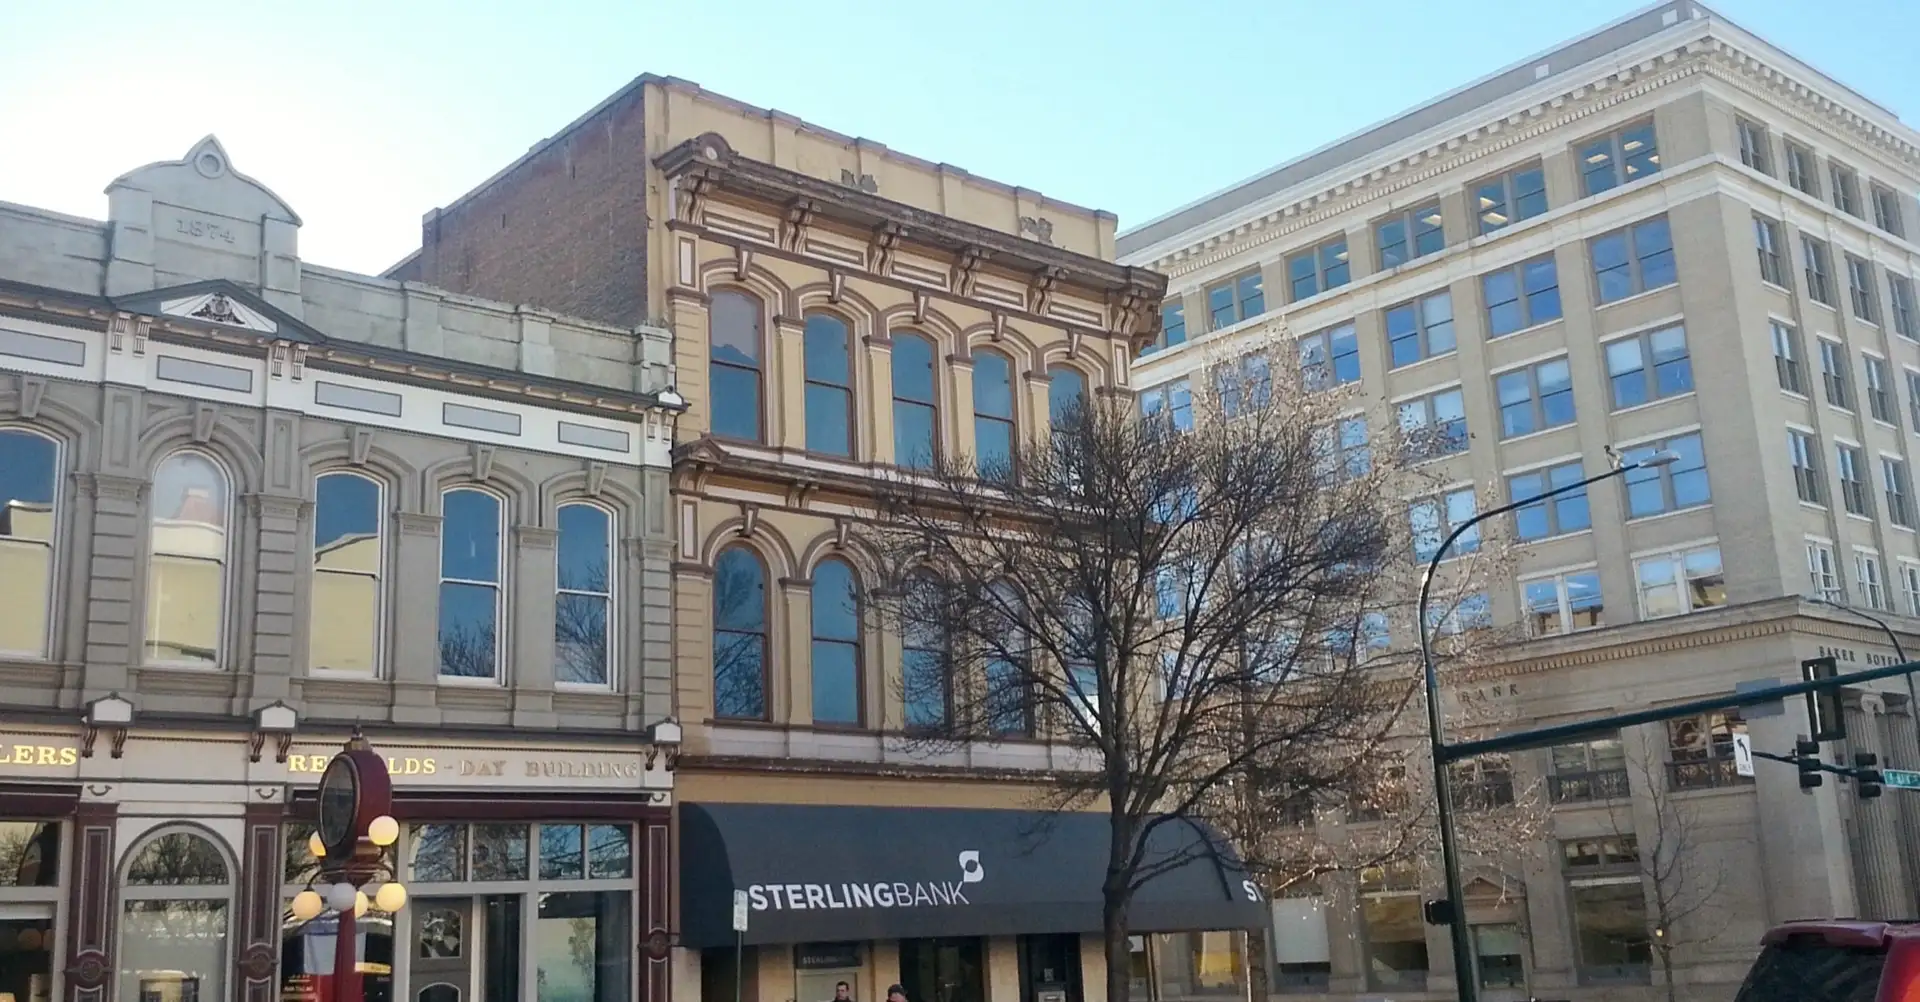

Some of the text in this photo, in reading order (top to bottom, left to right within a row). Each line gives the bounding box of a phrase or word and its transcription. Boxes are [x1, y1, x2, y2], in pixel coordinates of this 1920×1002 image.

[176, 219, 236, 244] 1874
[1818, 645, 1856, 662] BAKER
[288, 754, 436, 775] RELDS
[524, 760, 637, 779] BUILDING
